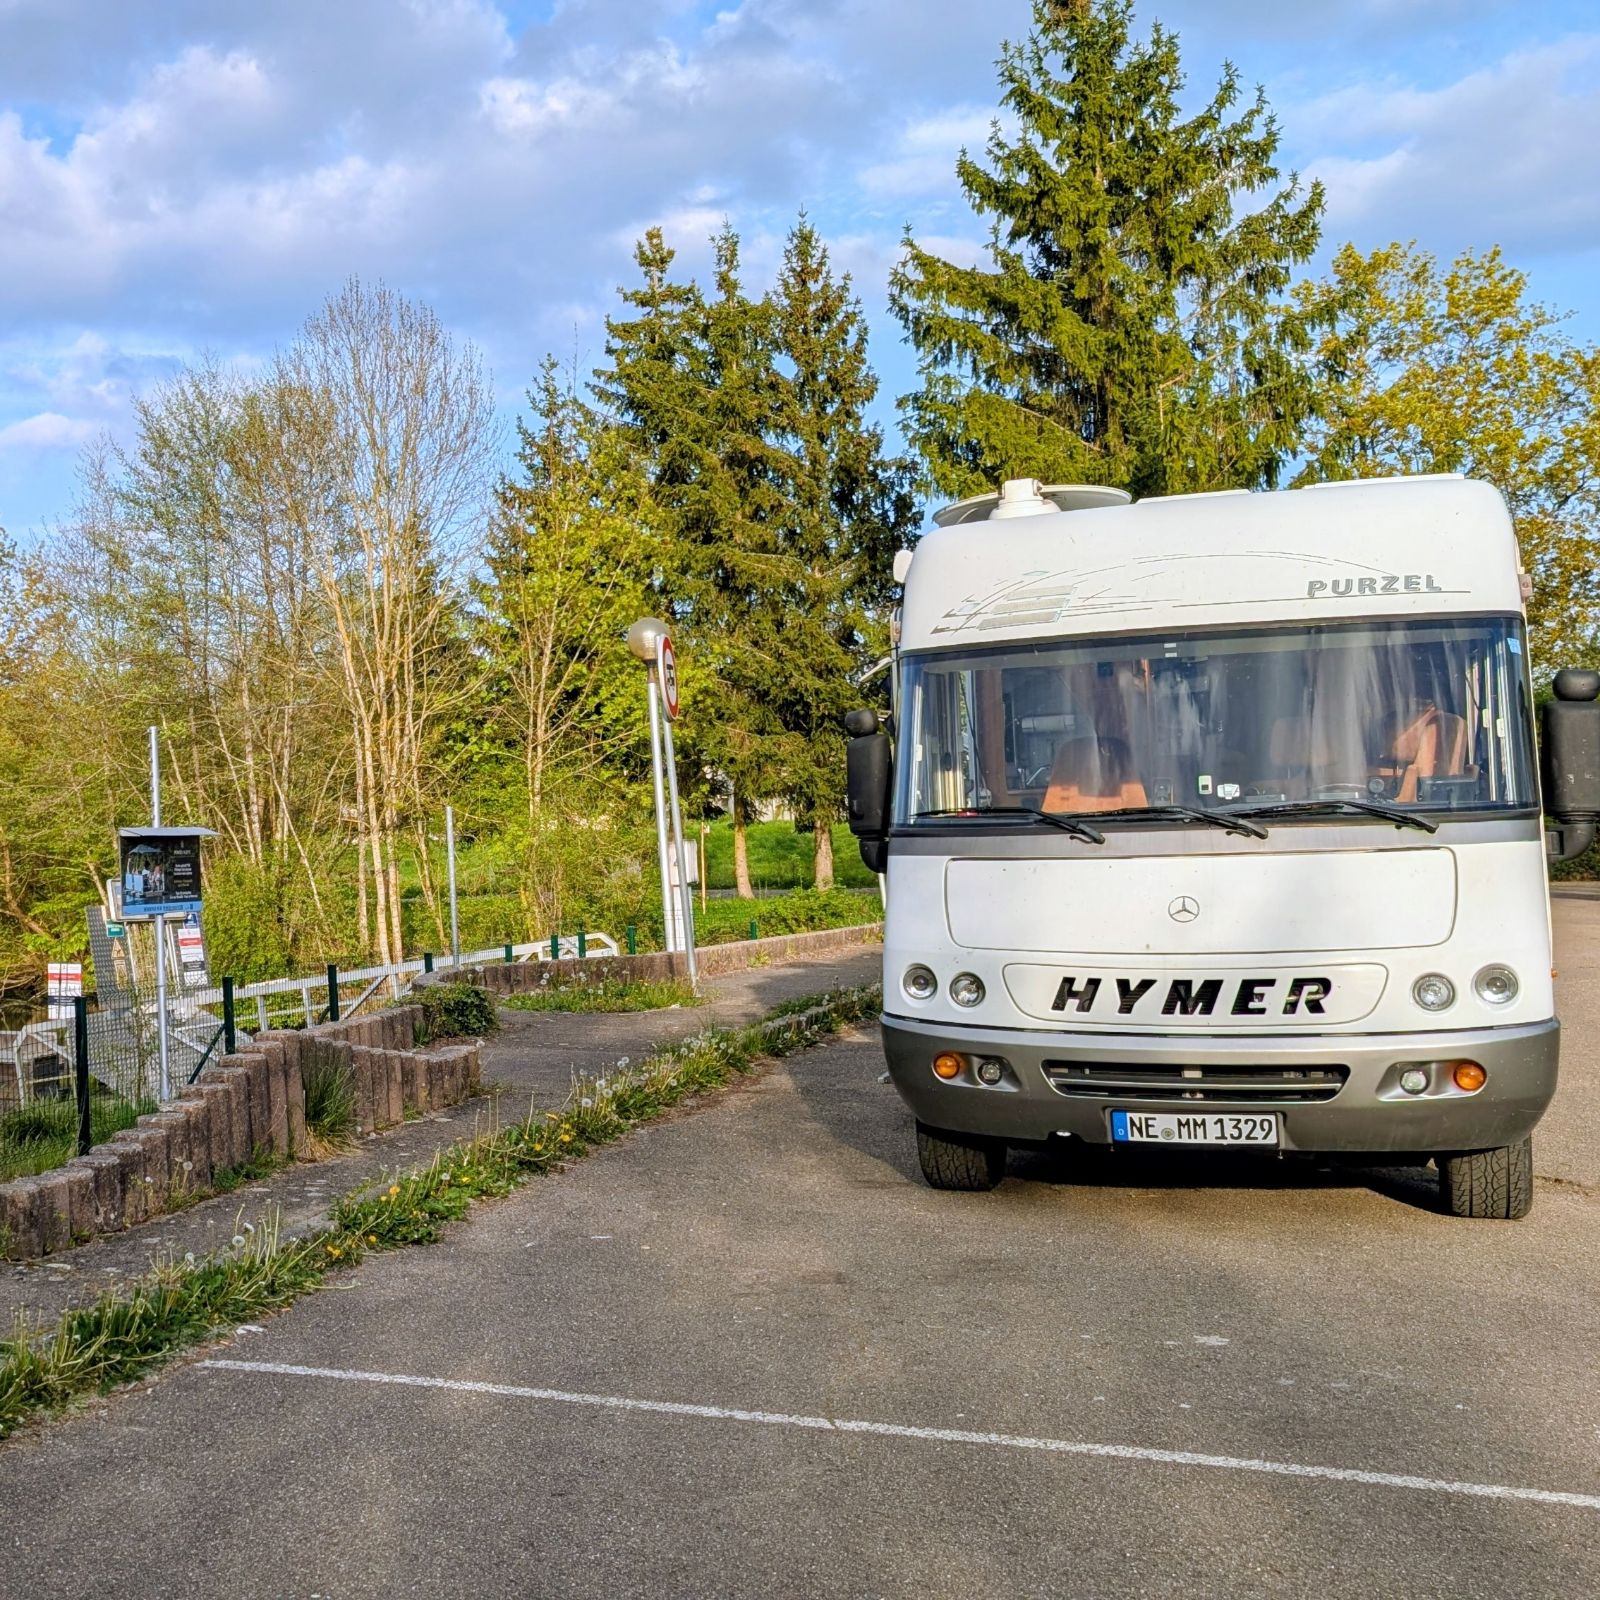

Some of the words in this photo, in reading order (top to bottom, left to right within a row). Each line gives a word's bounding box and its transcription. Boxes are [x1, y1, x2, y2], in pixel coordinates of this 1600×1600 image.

[1307, 575, 1442, 598] PURZEL
[1051, 977, 1332, 1015] HYMER
[1129, 1117, 1159, 1139] NE
[1177, 1118, 1207, 1140] MM
[1213, 1118, 1273, 1141] 1329
